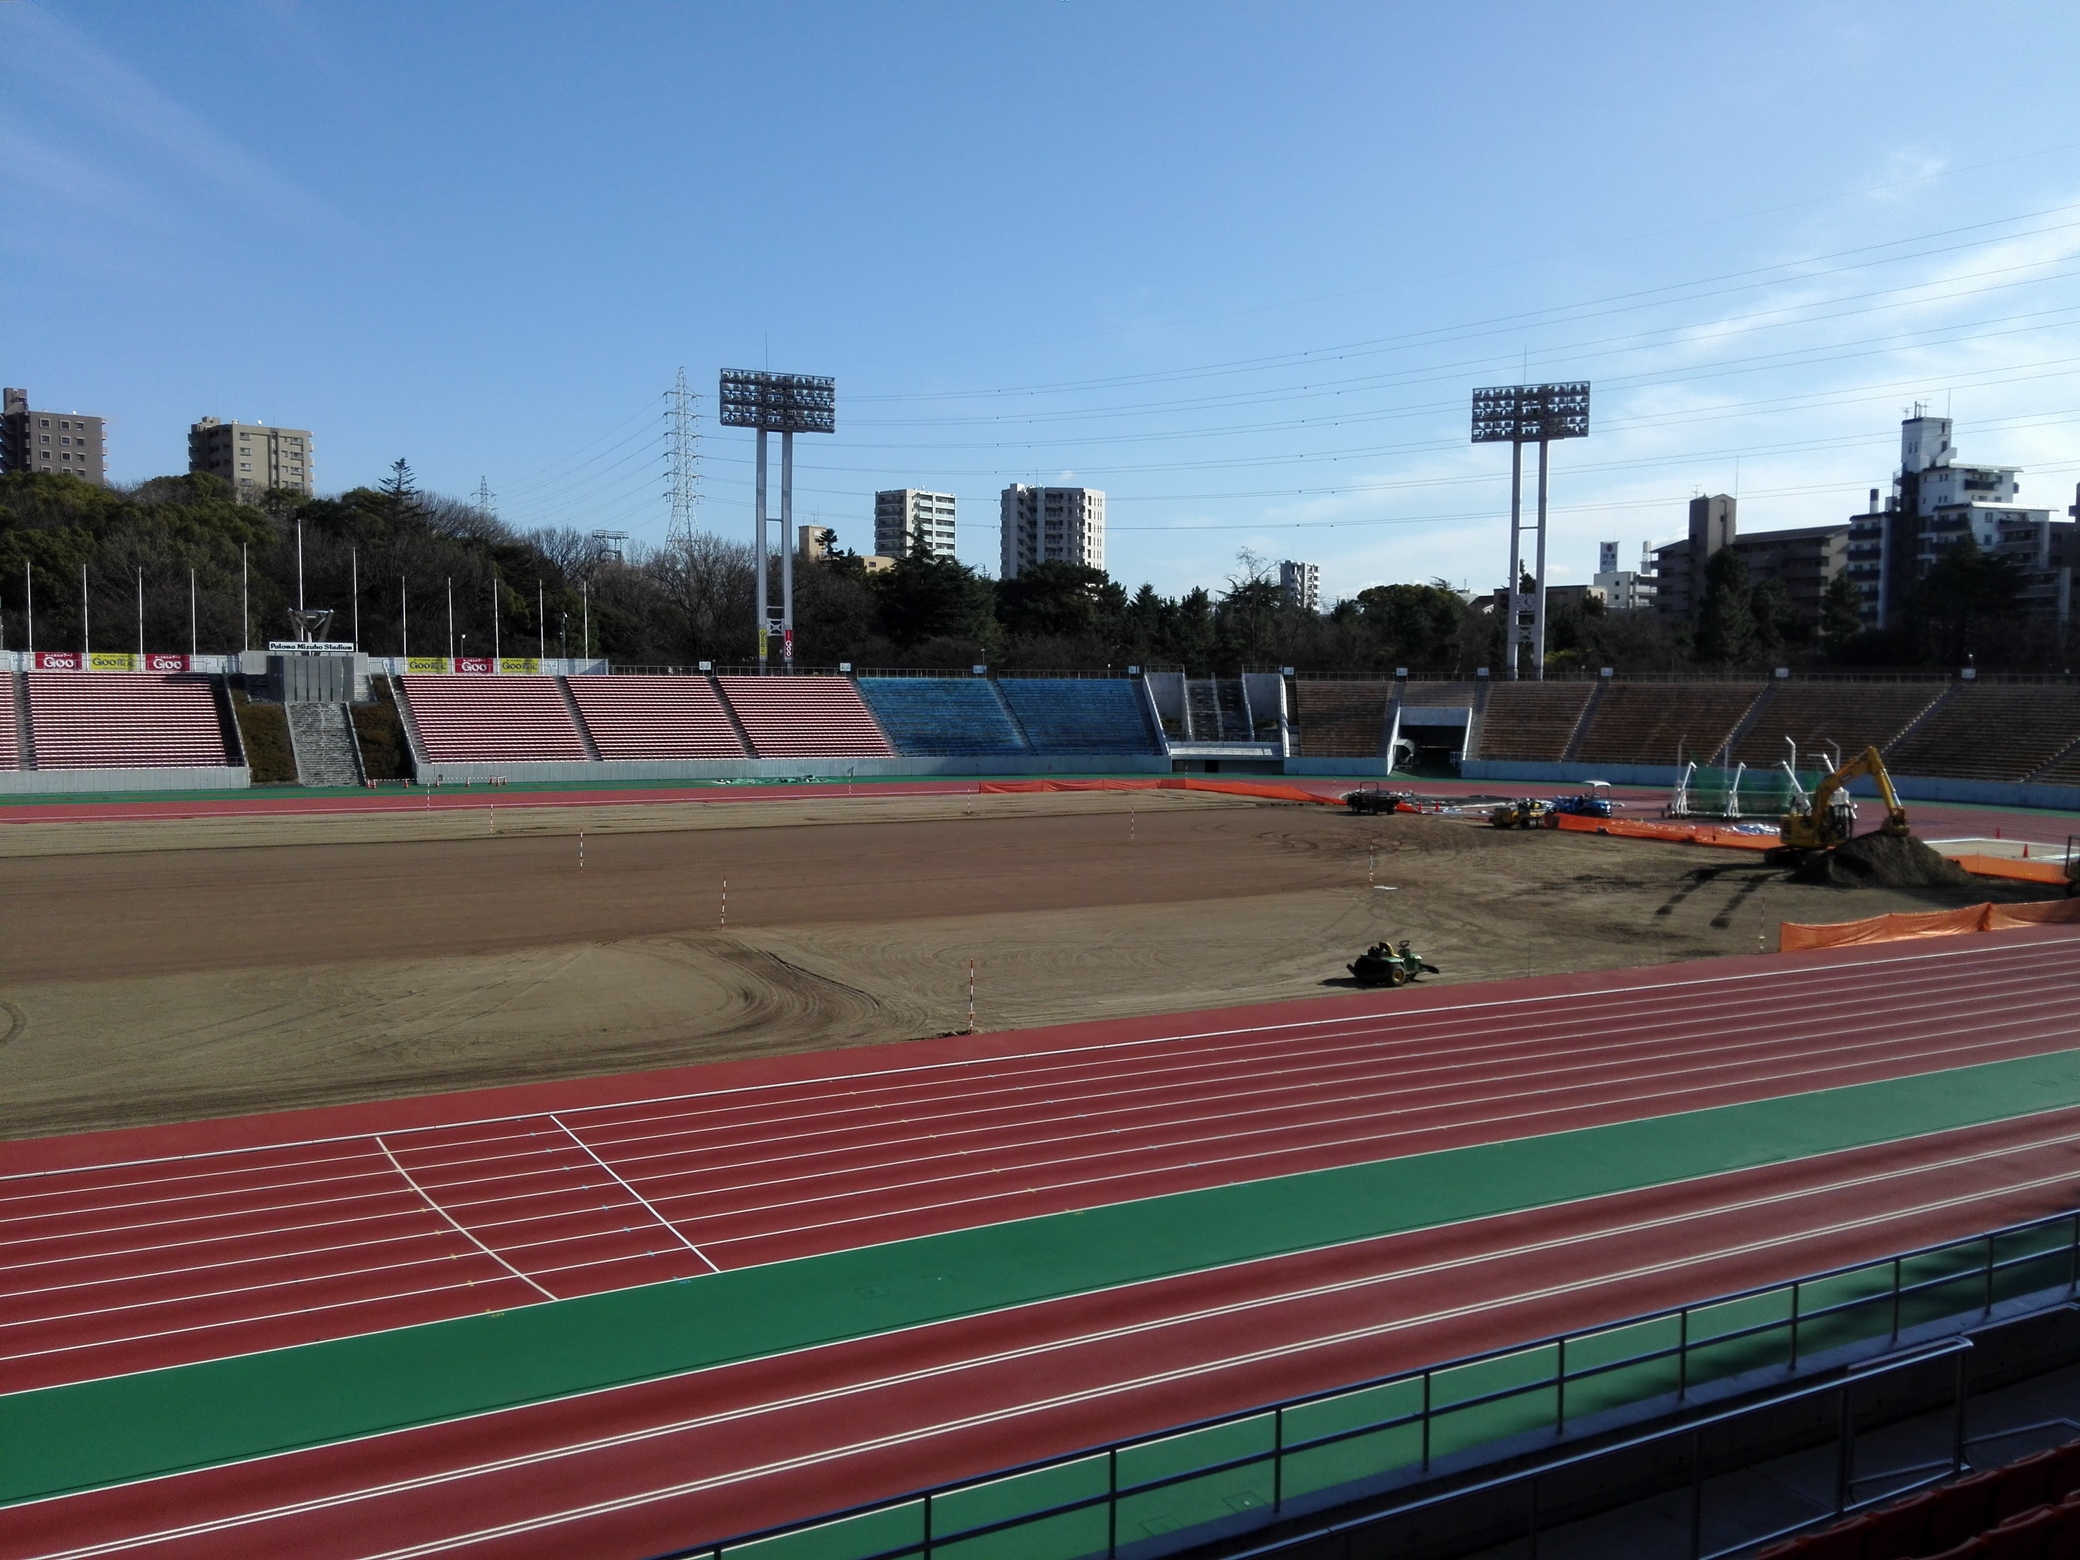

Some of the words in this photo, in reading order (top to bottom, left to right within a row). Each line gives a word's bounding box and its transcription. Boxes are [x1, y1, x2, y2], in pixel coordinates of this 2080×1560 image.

[323, 643, 353, 651] Stadium
[43, 656, 75, 668] Goo
[153, 658, 183, 669] Goo
[461, 661, 487, 672] Goo
